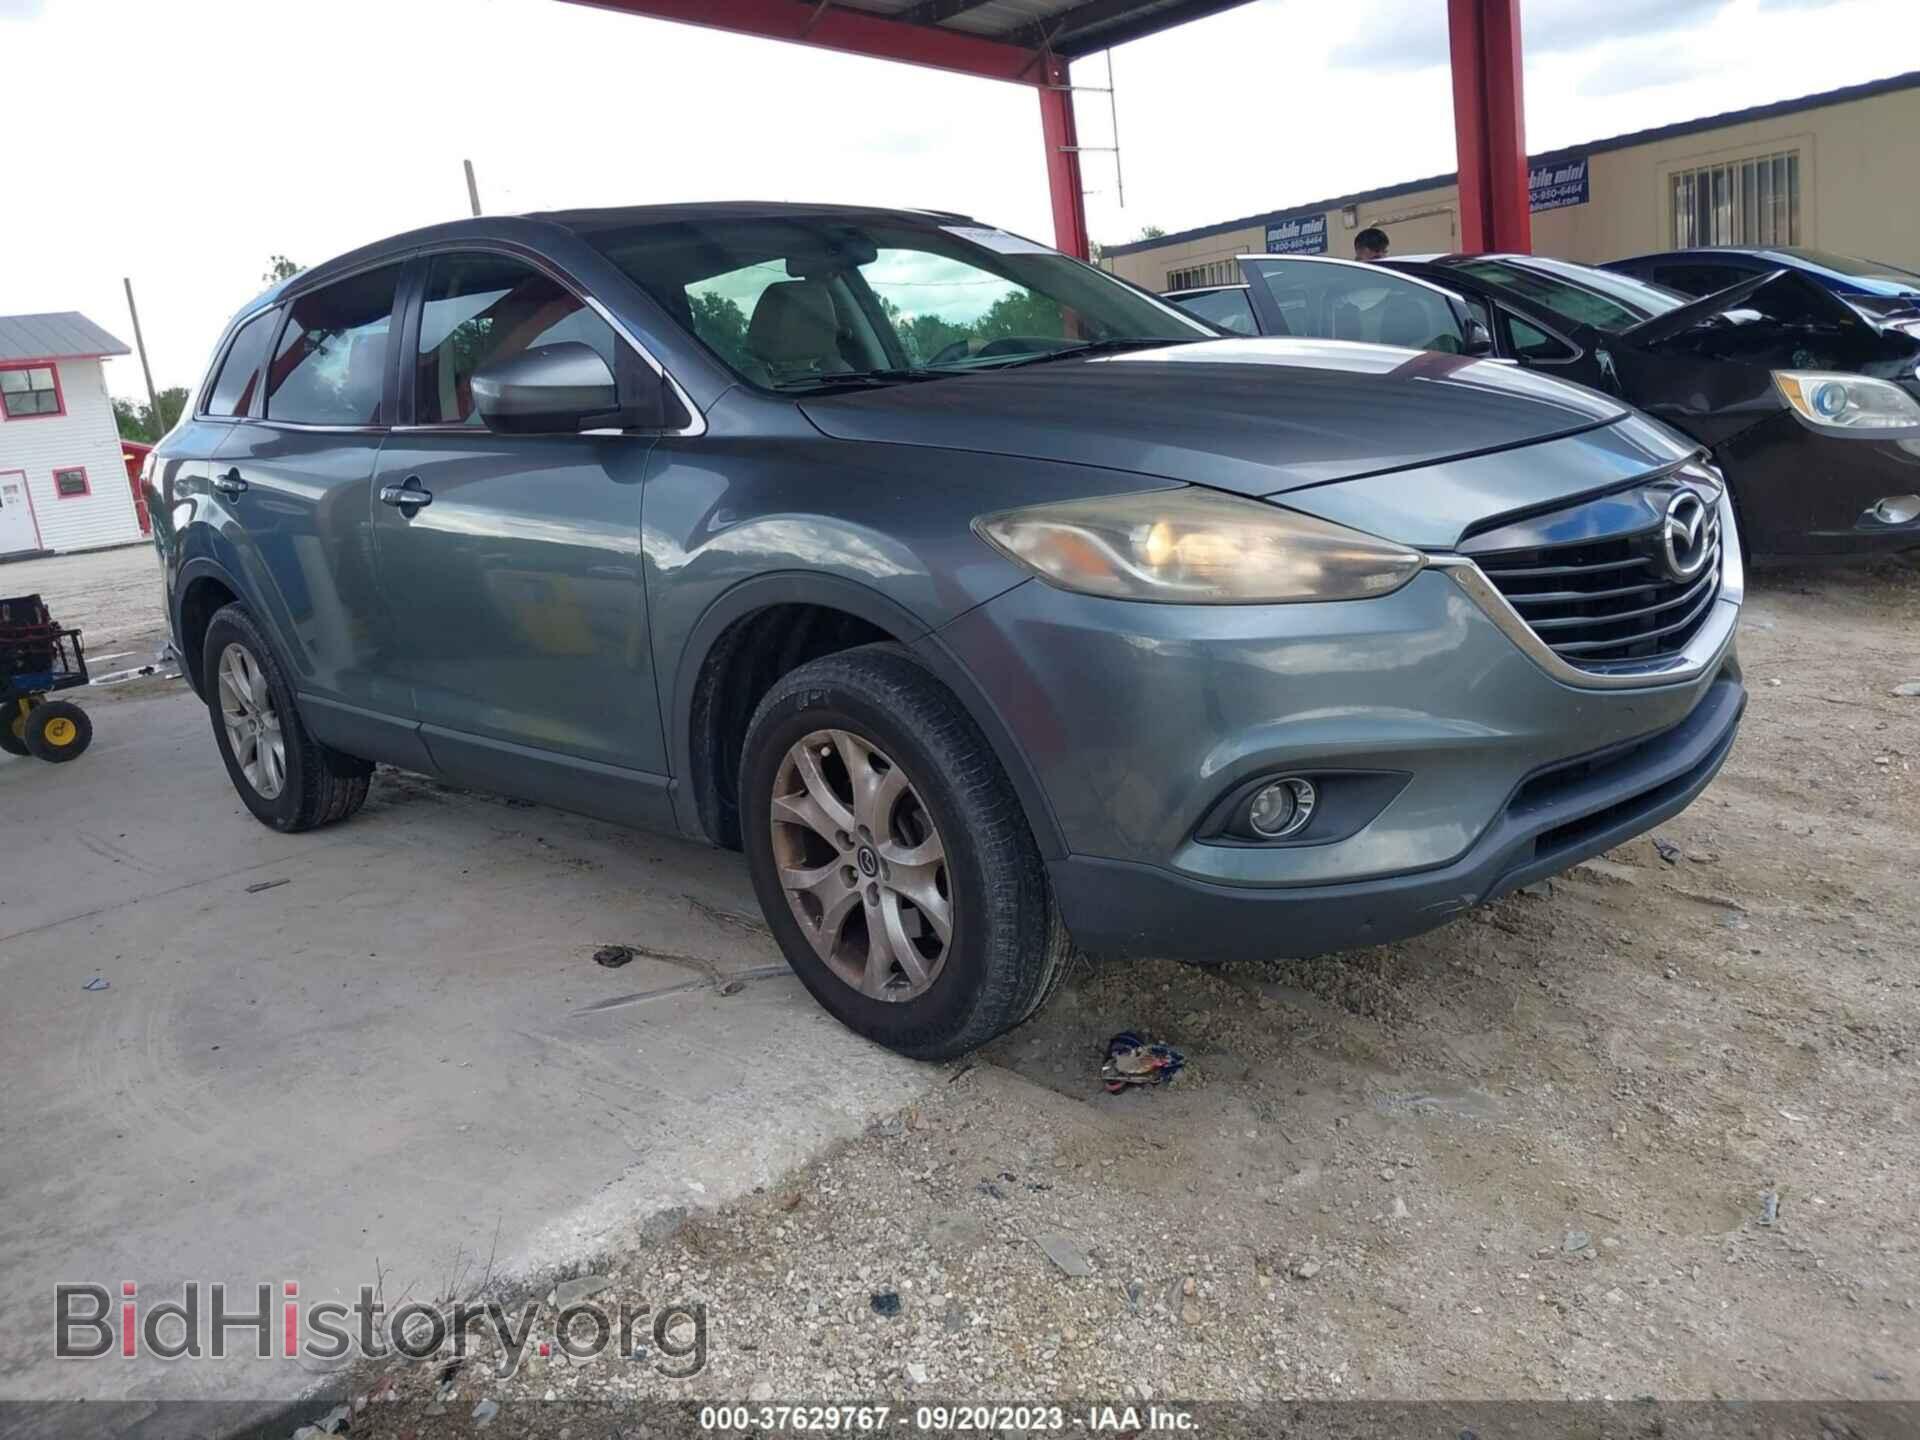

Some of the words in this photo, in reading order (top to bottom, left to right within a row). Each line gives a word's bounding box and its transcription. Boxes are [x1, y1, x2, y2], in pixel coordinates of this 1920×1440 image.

[1554, 161, 1585, 184] mini
[1268, 221, 1300, 241] mobile
[1301, 217, 1324, 235] mini
